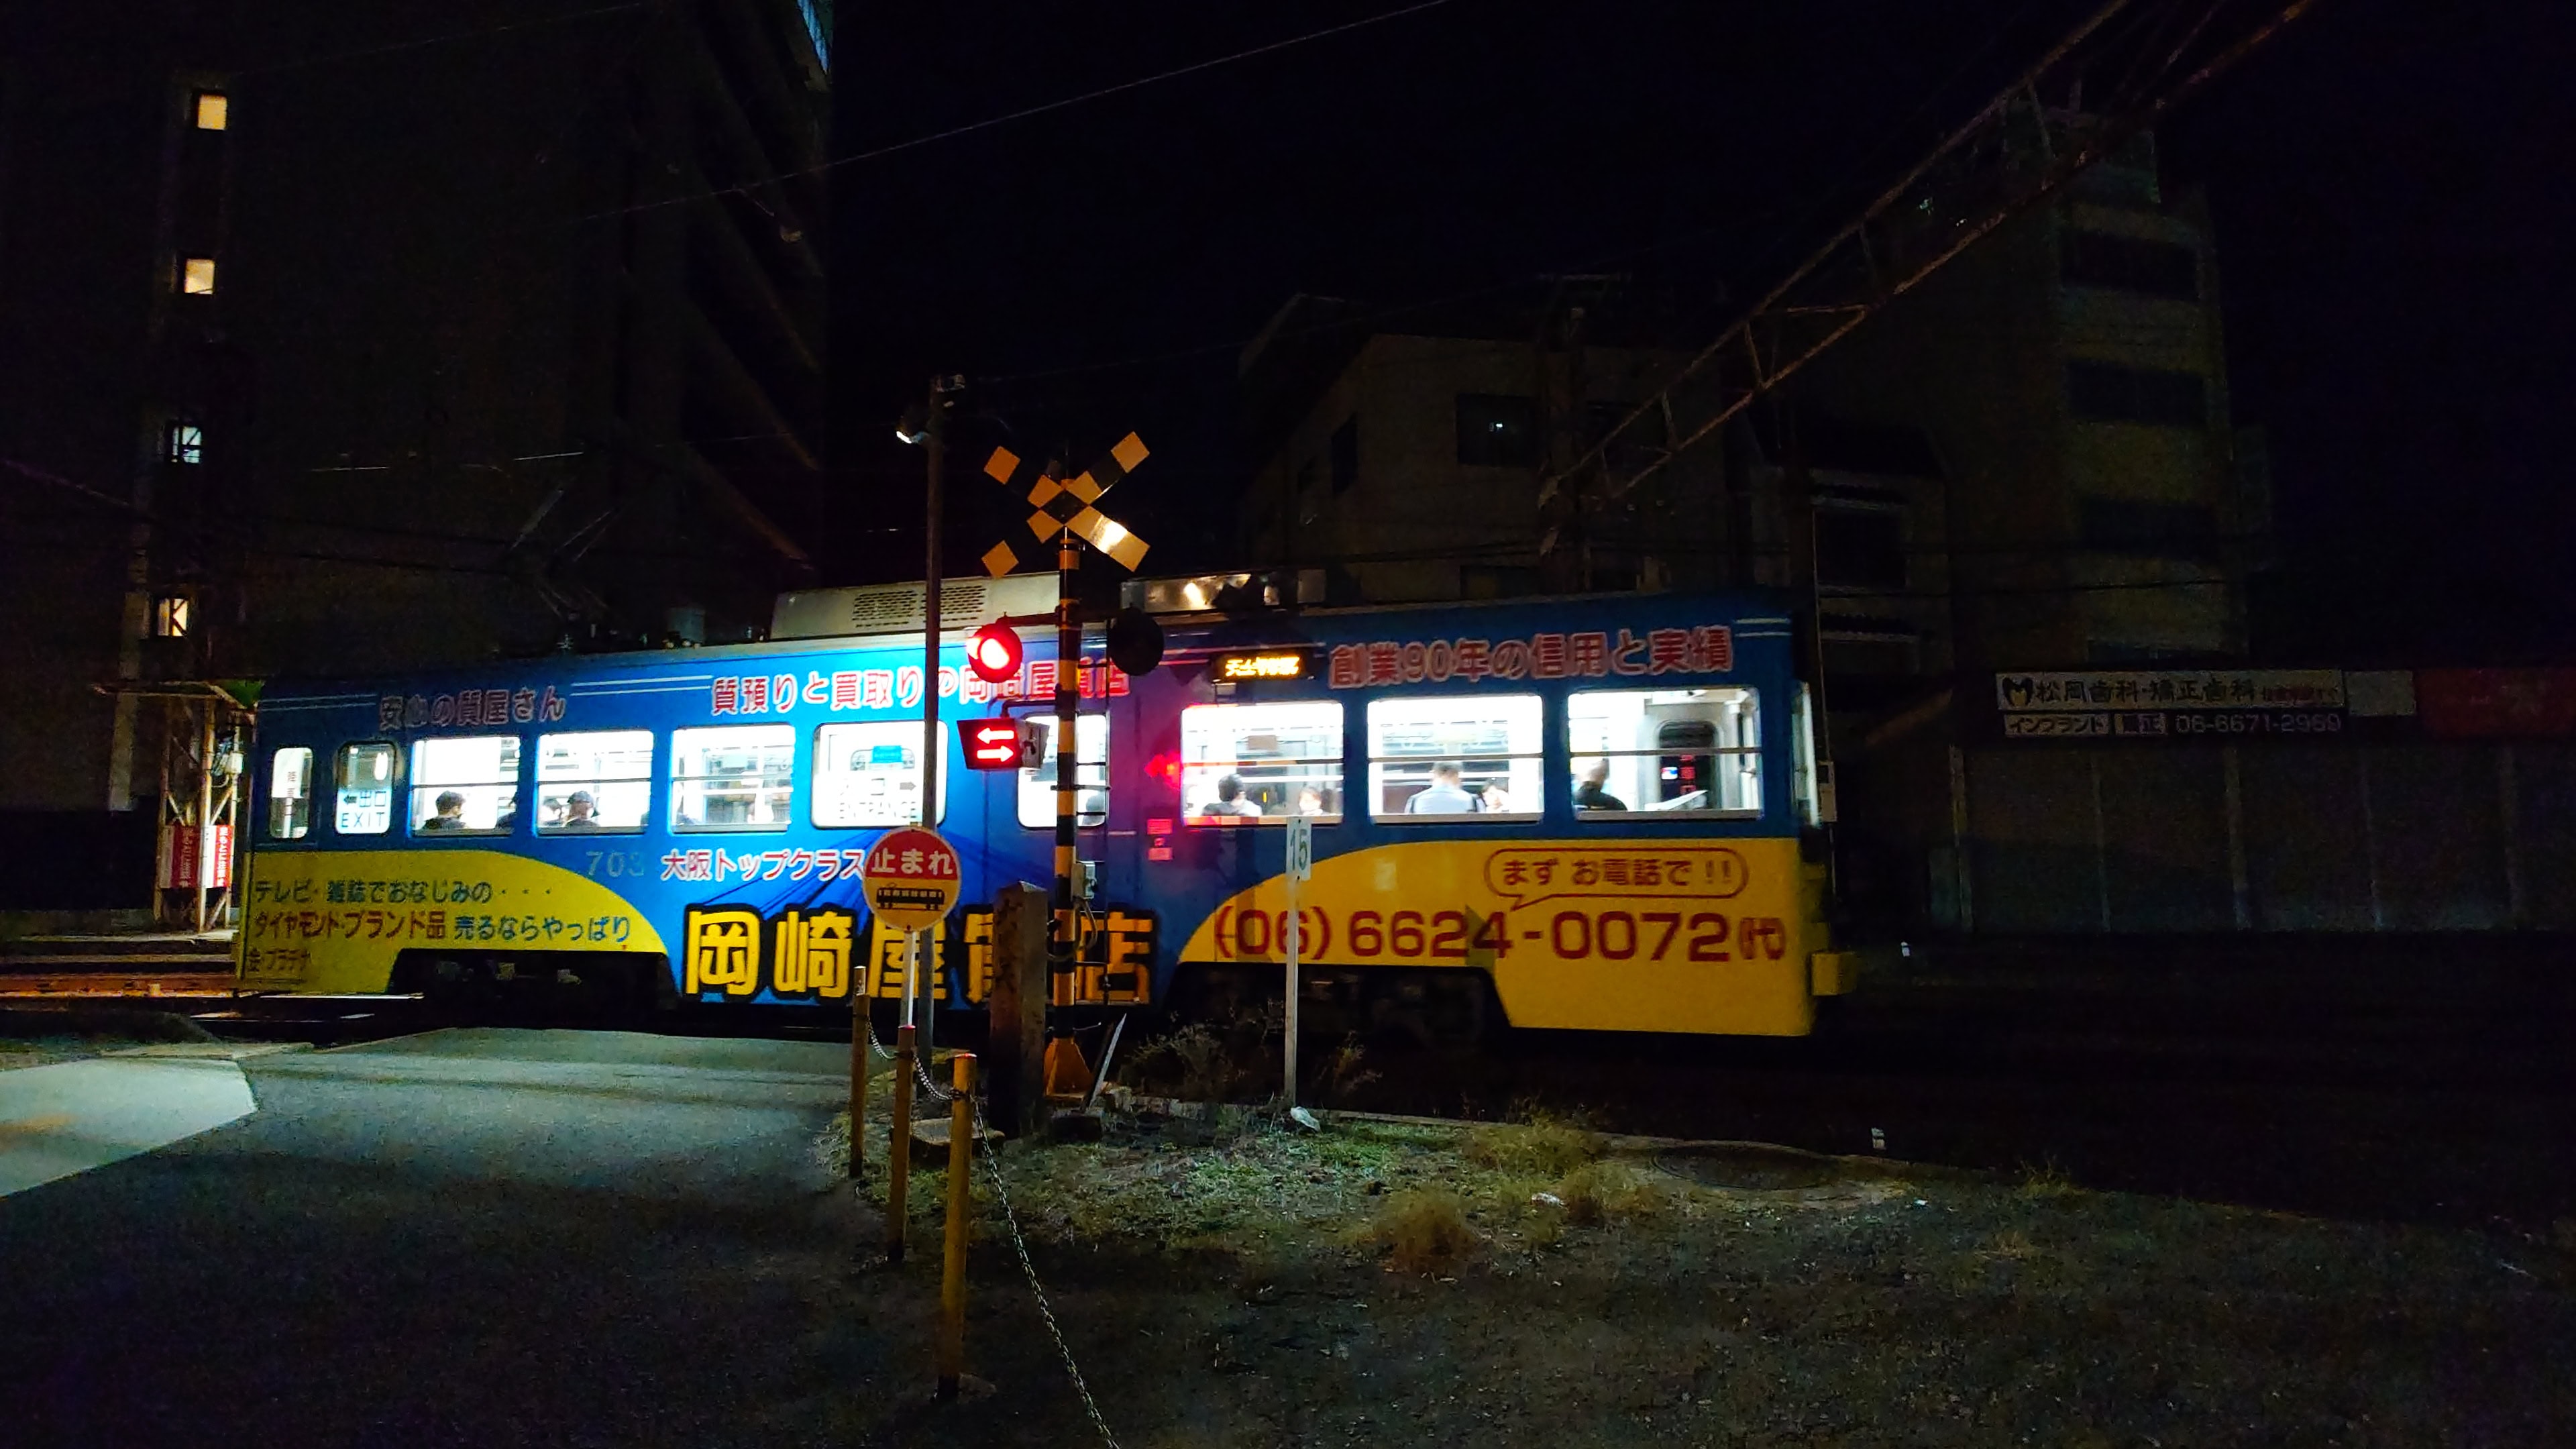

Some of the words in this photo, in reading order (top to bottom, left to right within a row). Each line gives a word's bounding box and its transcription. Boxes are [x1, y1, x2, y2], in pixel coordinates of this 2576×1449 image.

[1328, 625, 1733, 690] 創業90年の信用と実績
[341, 812, 385, 828] EXIT
[873, 849, 954, 875] 止まれ
[1290, 828, 1308, 870] 15
[1503, 858, 1559, 886] まず
[1571, 858, 1692, 887] お電話で
[454, 915, 630, 942] 売るならやっぱり
